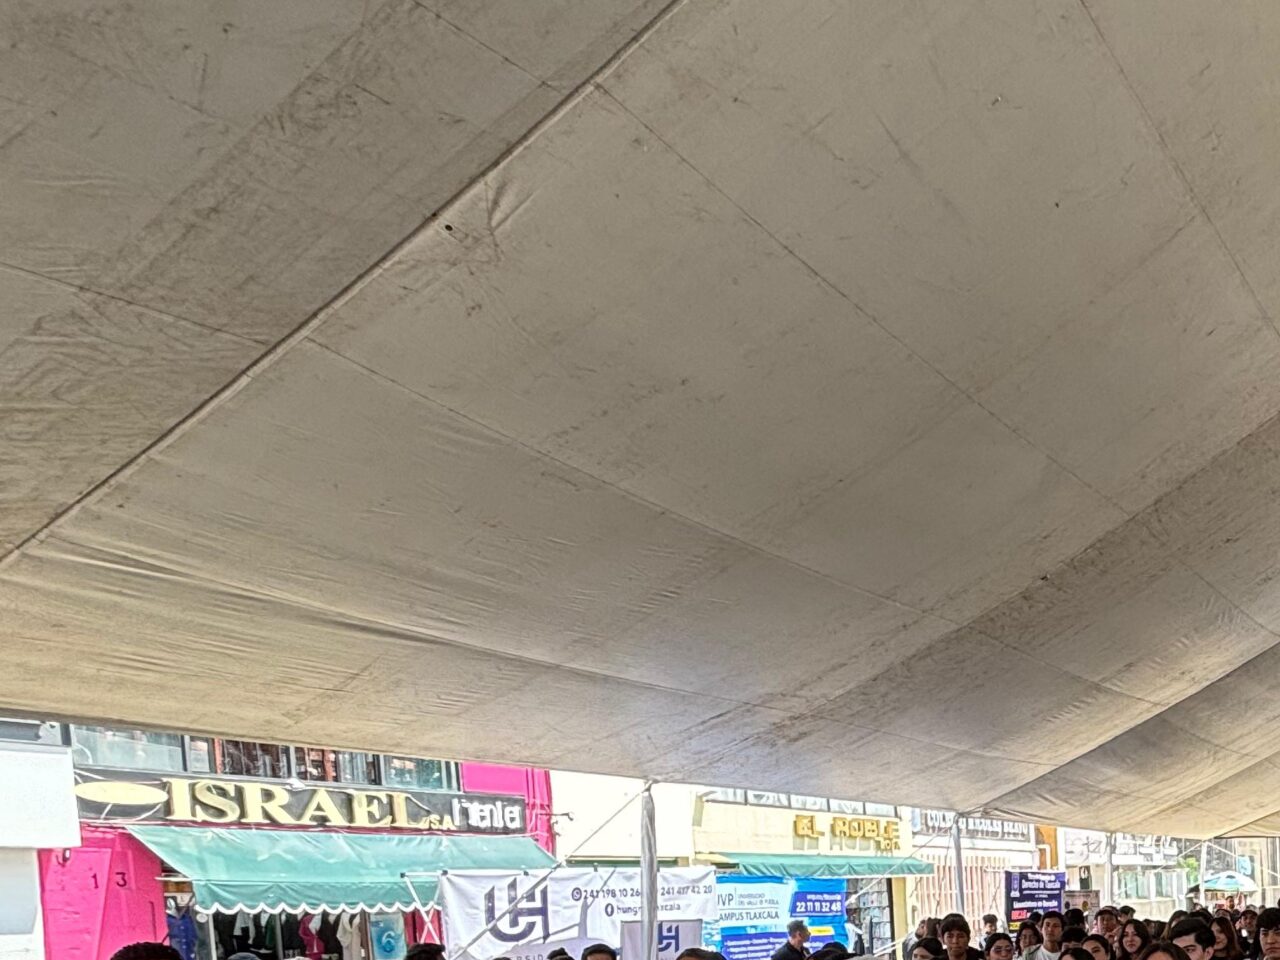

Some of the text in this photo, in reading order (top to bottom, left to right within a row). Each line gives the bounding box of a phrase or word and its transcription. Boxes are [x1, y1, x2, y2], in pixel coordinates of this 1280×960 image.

[165, 777, 429, 830] ISRAEL
[795, 815, 899, 839] EL ROBLE
[660, 886, 674, 896] 241
[796, 902, 806, 912] 22
[821, 902, 830, 912] 32
[719, 911, 779, 921] AMPUS TLAXCALA
